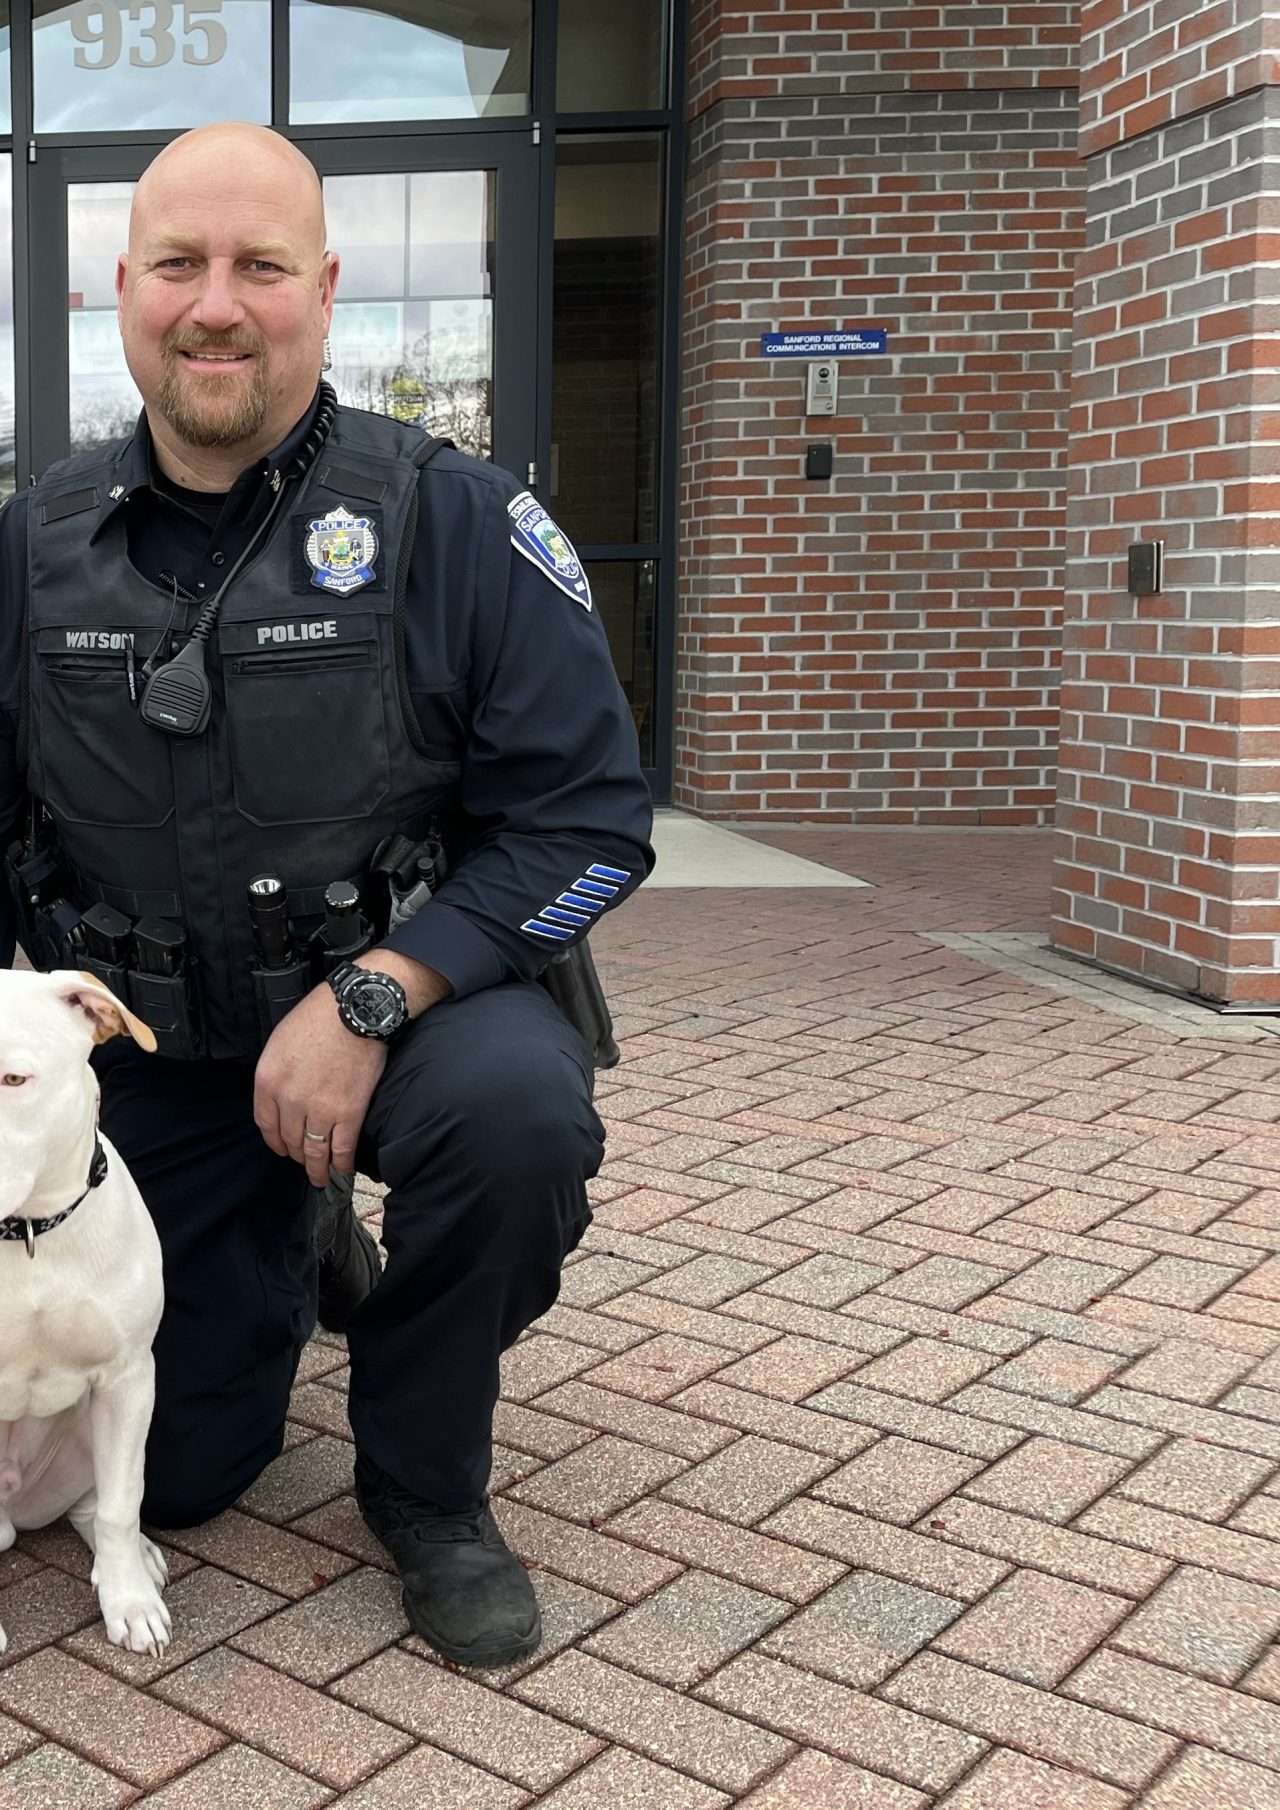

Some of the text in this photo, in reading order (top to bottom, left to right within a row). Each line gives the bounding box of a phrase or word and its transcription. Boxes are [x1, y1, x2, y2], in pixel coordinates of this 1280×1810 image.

[70, 0, 228, 70] 935
[784, 334, 862, 344] SANFORD REGIONAL
[766, 342, 880, 353] COMMUNICATIONS INTERCOM
[318, 520, 361, 531] POLICE
[324, 574, 363, 585] SANFORD
[257, 620, 338, 645] POLICE
[66, 631, 135, 650] WATSON
